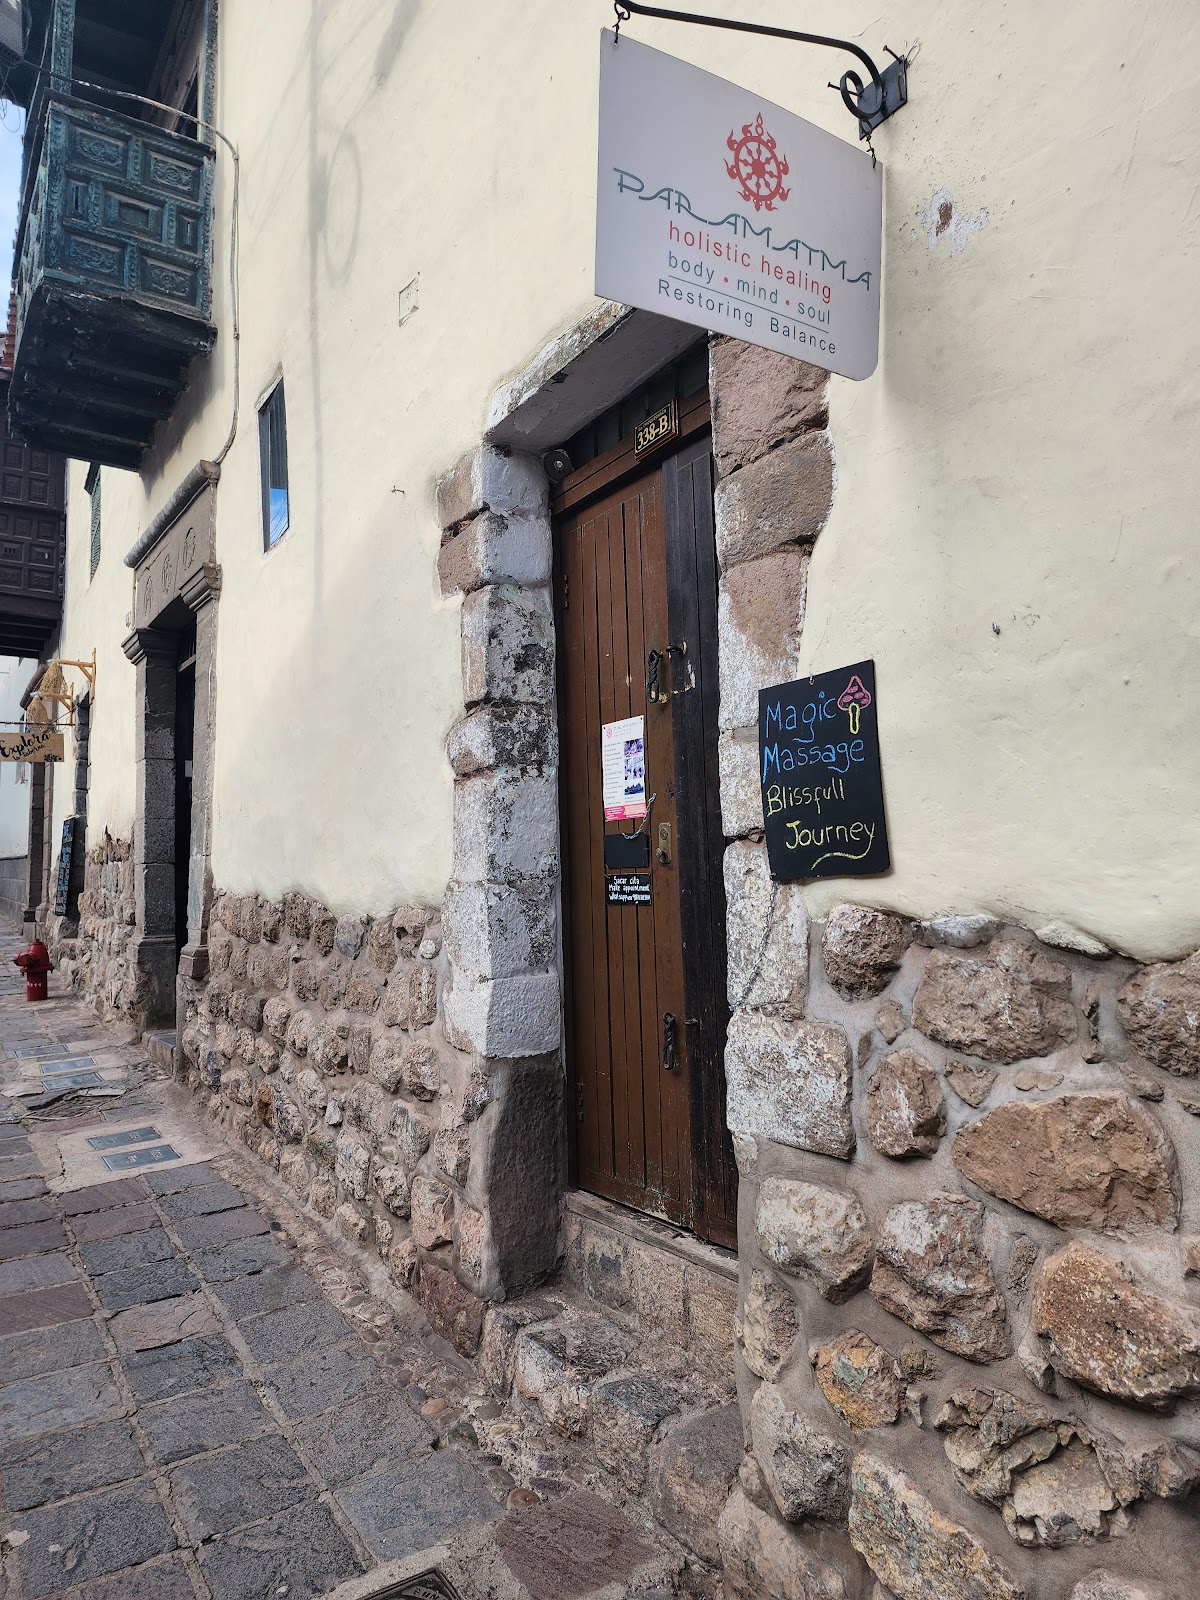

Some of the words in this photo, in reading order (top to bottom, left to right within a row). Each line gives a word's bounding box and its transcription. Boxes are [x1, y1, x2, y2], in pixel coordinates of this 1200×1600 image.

[613, 167, 872, 291] PARAMATMA
[668, 251, 715, 283] body
[737, 278, 778, 304] mind
[797, 302, 830, 325] soul
[669, 221, 751, 268] holistic
[761, 255, 831, 304] healing
[658, 278, 753, 328] Restoring
[770, 317, 836, 354] Balance
[637, 414, 668, 450] 338-B
[765, 690, 836, 744] Magic
[762, 738, 864, 785] Massage
[766, 777, 845, 817] Blissfull
[785, 820, 875, 866] Journey
